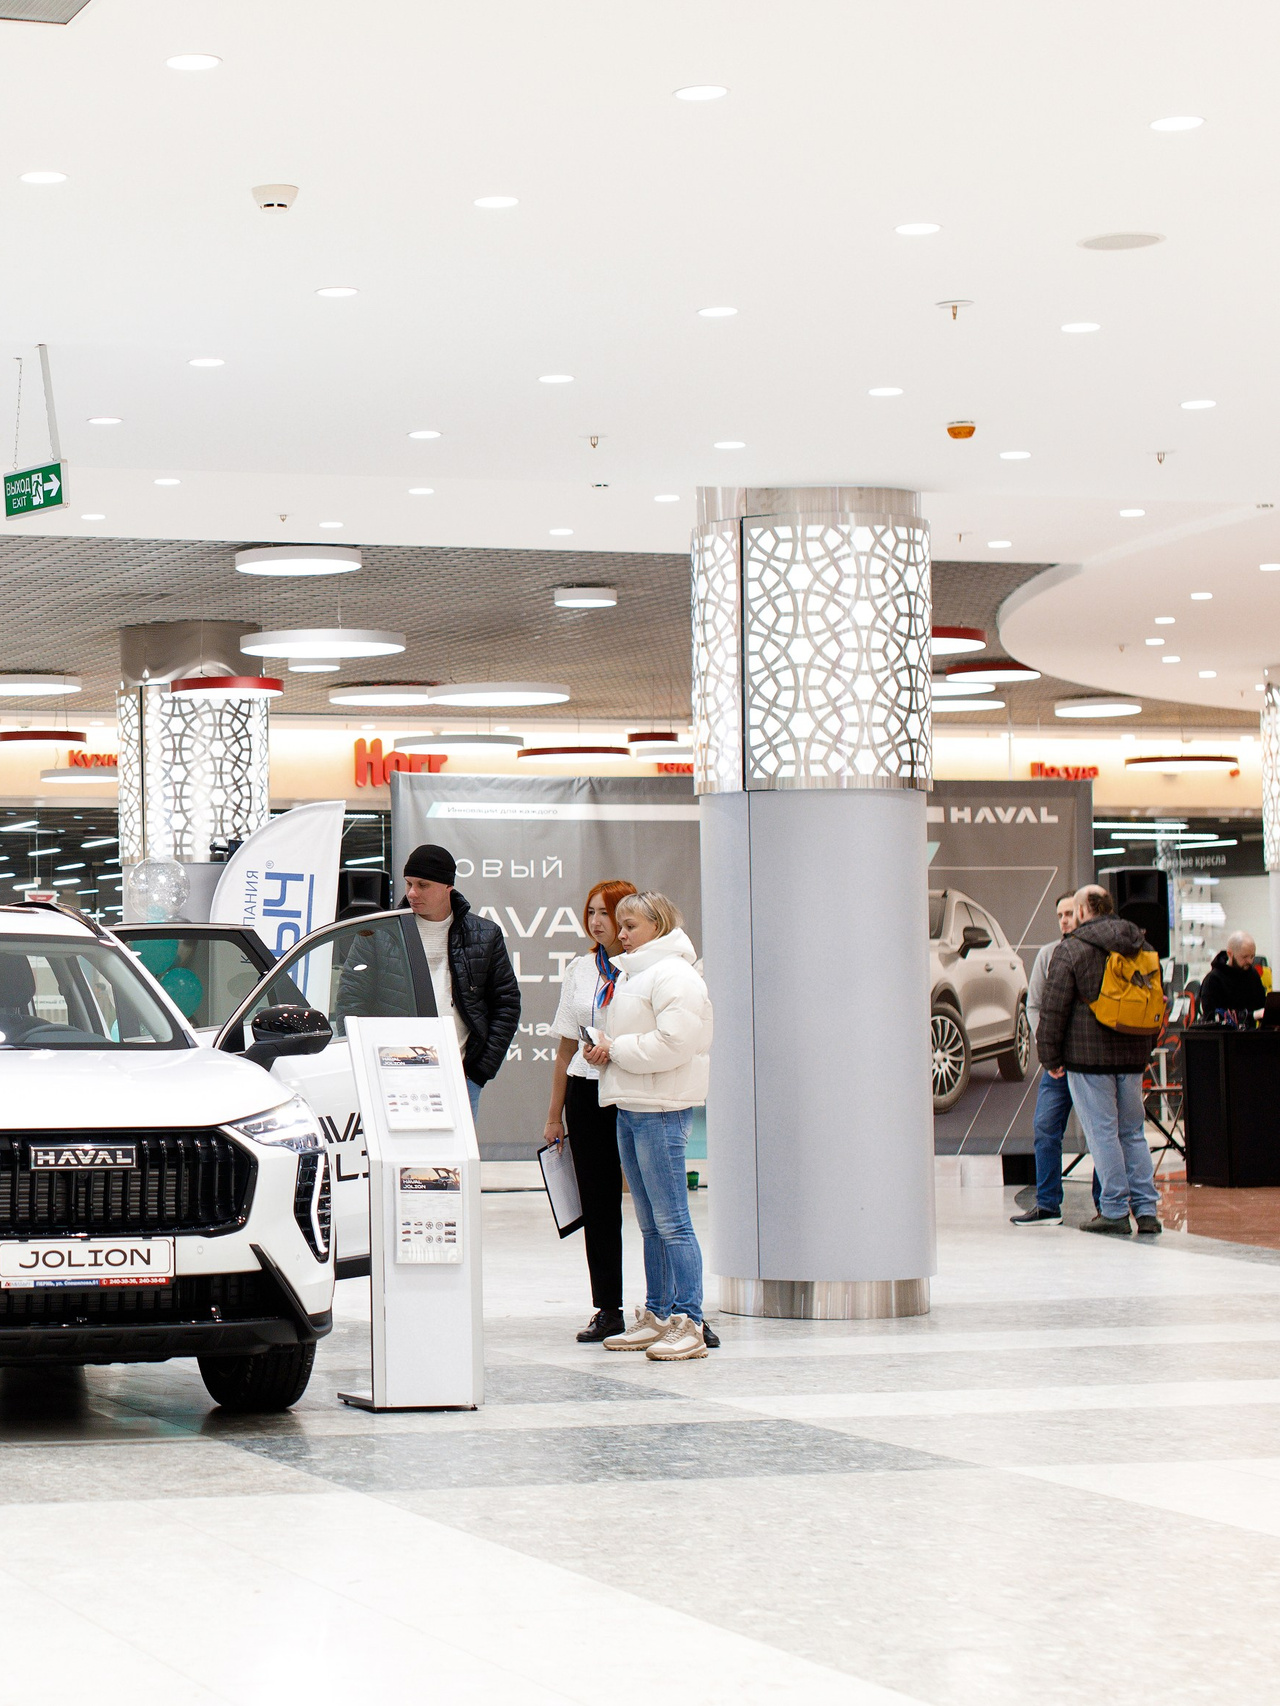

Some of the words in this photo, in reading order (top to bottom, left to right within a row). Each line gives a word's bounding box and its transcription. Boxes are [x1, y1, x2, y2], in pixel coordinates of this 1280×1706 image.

[6, 478, 31, 496] ВЫХОД
[12, 496, 27, 509] EXIT
[68, 749, 118, 769] Кухн
[950, 806, 1059, 824] HAVAL
[455, 855, 564, 879] ОВЫЙ
[1195, 854, 1227, 870] кресла
[477, 906, 587, 938] AVA
[37, 1150, 132, 1165] HAVAL
[19, 1248, 151, 1269] JOLION
